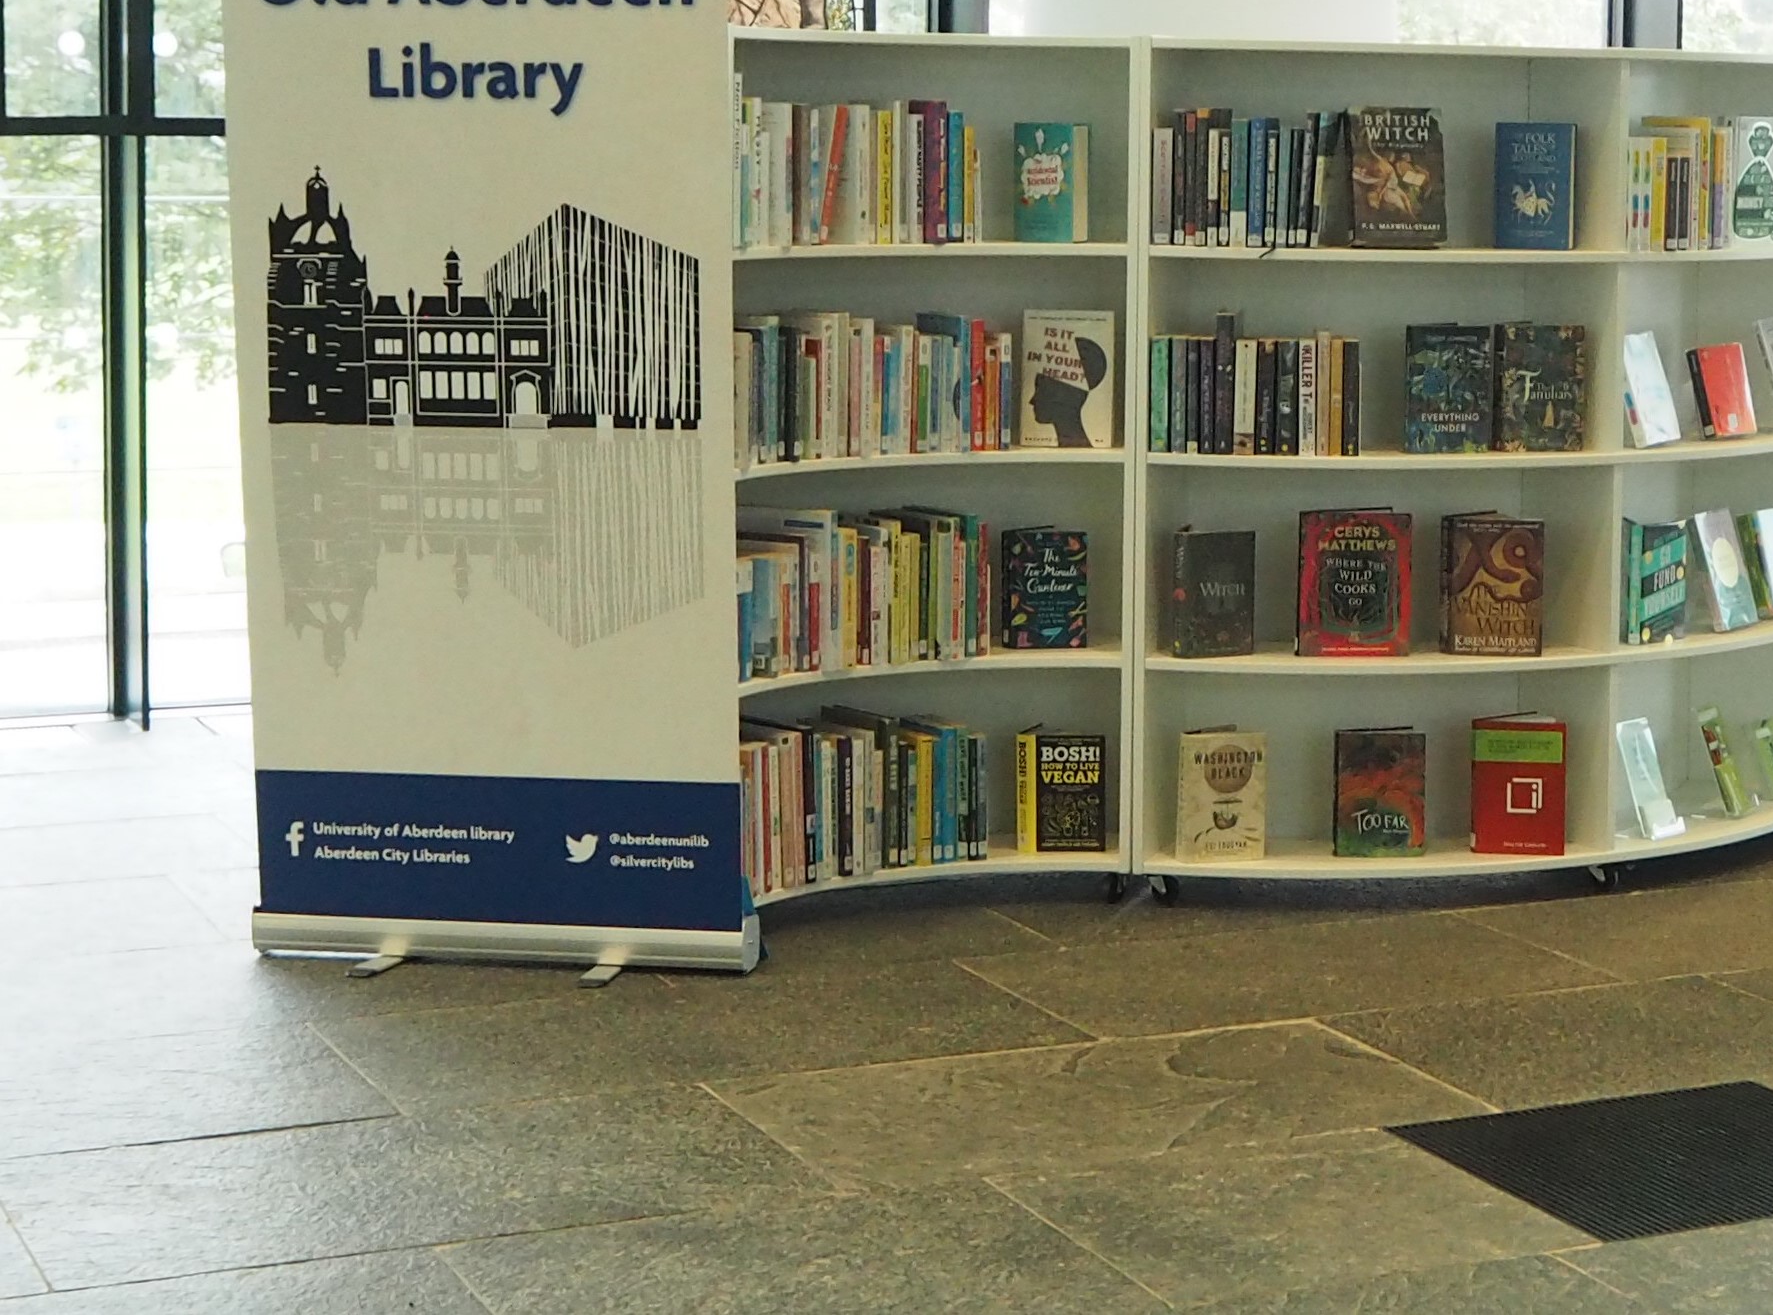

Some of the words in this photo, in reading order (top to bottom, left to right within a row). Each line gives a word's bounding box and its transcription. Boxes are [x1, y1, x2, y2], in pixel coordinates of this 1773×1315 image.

[367, 42, 584, 116] Library
[1364, 111, 1430, 127] BRITISH
[1366, 127, 1429, 141] WITCH
[1525, 133, 1555, 144] FOLK
[1512, 143, 1547, 155] TALES
[1044, 327, 1057, 338] IS
[1061, 328, 1074, 340] IT
[1044, 341, 1069, 353] ALL
[1027, 351, 1042, 362] IN
[1046, 354, 1082, 369] YOUR
[1301, 346, 1313, 388] KILLER
[1421, 412, 1480, 423] EVERYTHING
[1434, 423, 1466, 433] UNDER
[1334, 526, 1380, 538] CERYS
[1318, 540, 1396, 552] MATTHEWS
[1043, 548, 1059, 563] The
[1326, 558, 1361, 568] WHERE
[1339, 569, 1373, 582] WILD
[1654, 565, 1676, 592] FUND
[1334, 583, 1376, 595] COOKS
[1348, 598, 1362, 606] GO
[1477, 617, 1535, 635] WITCH
[1454, 634, 1486, 646] KAREN
[1489, 635, 1537, 647] MAITLAND
[1040, 746, 1100, 762] BOSH!
[1194, 750, 1263, 764] WASHINGTON
[1041, 762, 1064, 771] HOW
[1065, 762, 1078, 771] TO
[1079, 762, 1100, 771] LIVE
[1040, 771, 1100, 784] VEGAN
[1211, 767, 1245, 780] BLACK
[1384, 814, 1409, 829] FAR
[313, 822, 381, 840] University
[384, 822, 400, 838] of
[402, 825, 468, 840] Aberdeen
[470, 826, 515, 844] library
[609, 833, 709, 849] @aberdeenunilib
[314, 846, 379, 862] Aberdeen
[382, 847, 410, 865] City
[413, 849, 470, 864] Libraries
[609, 855, 694, 870] @silvercitylibs
